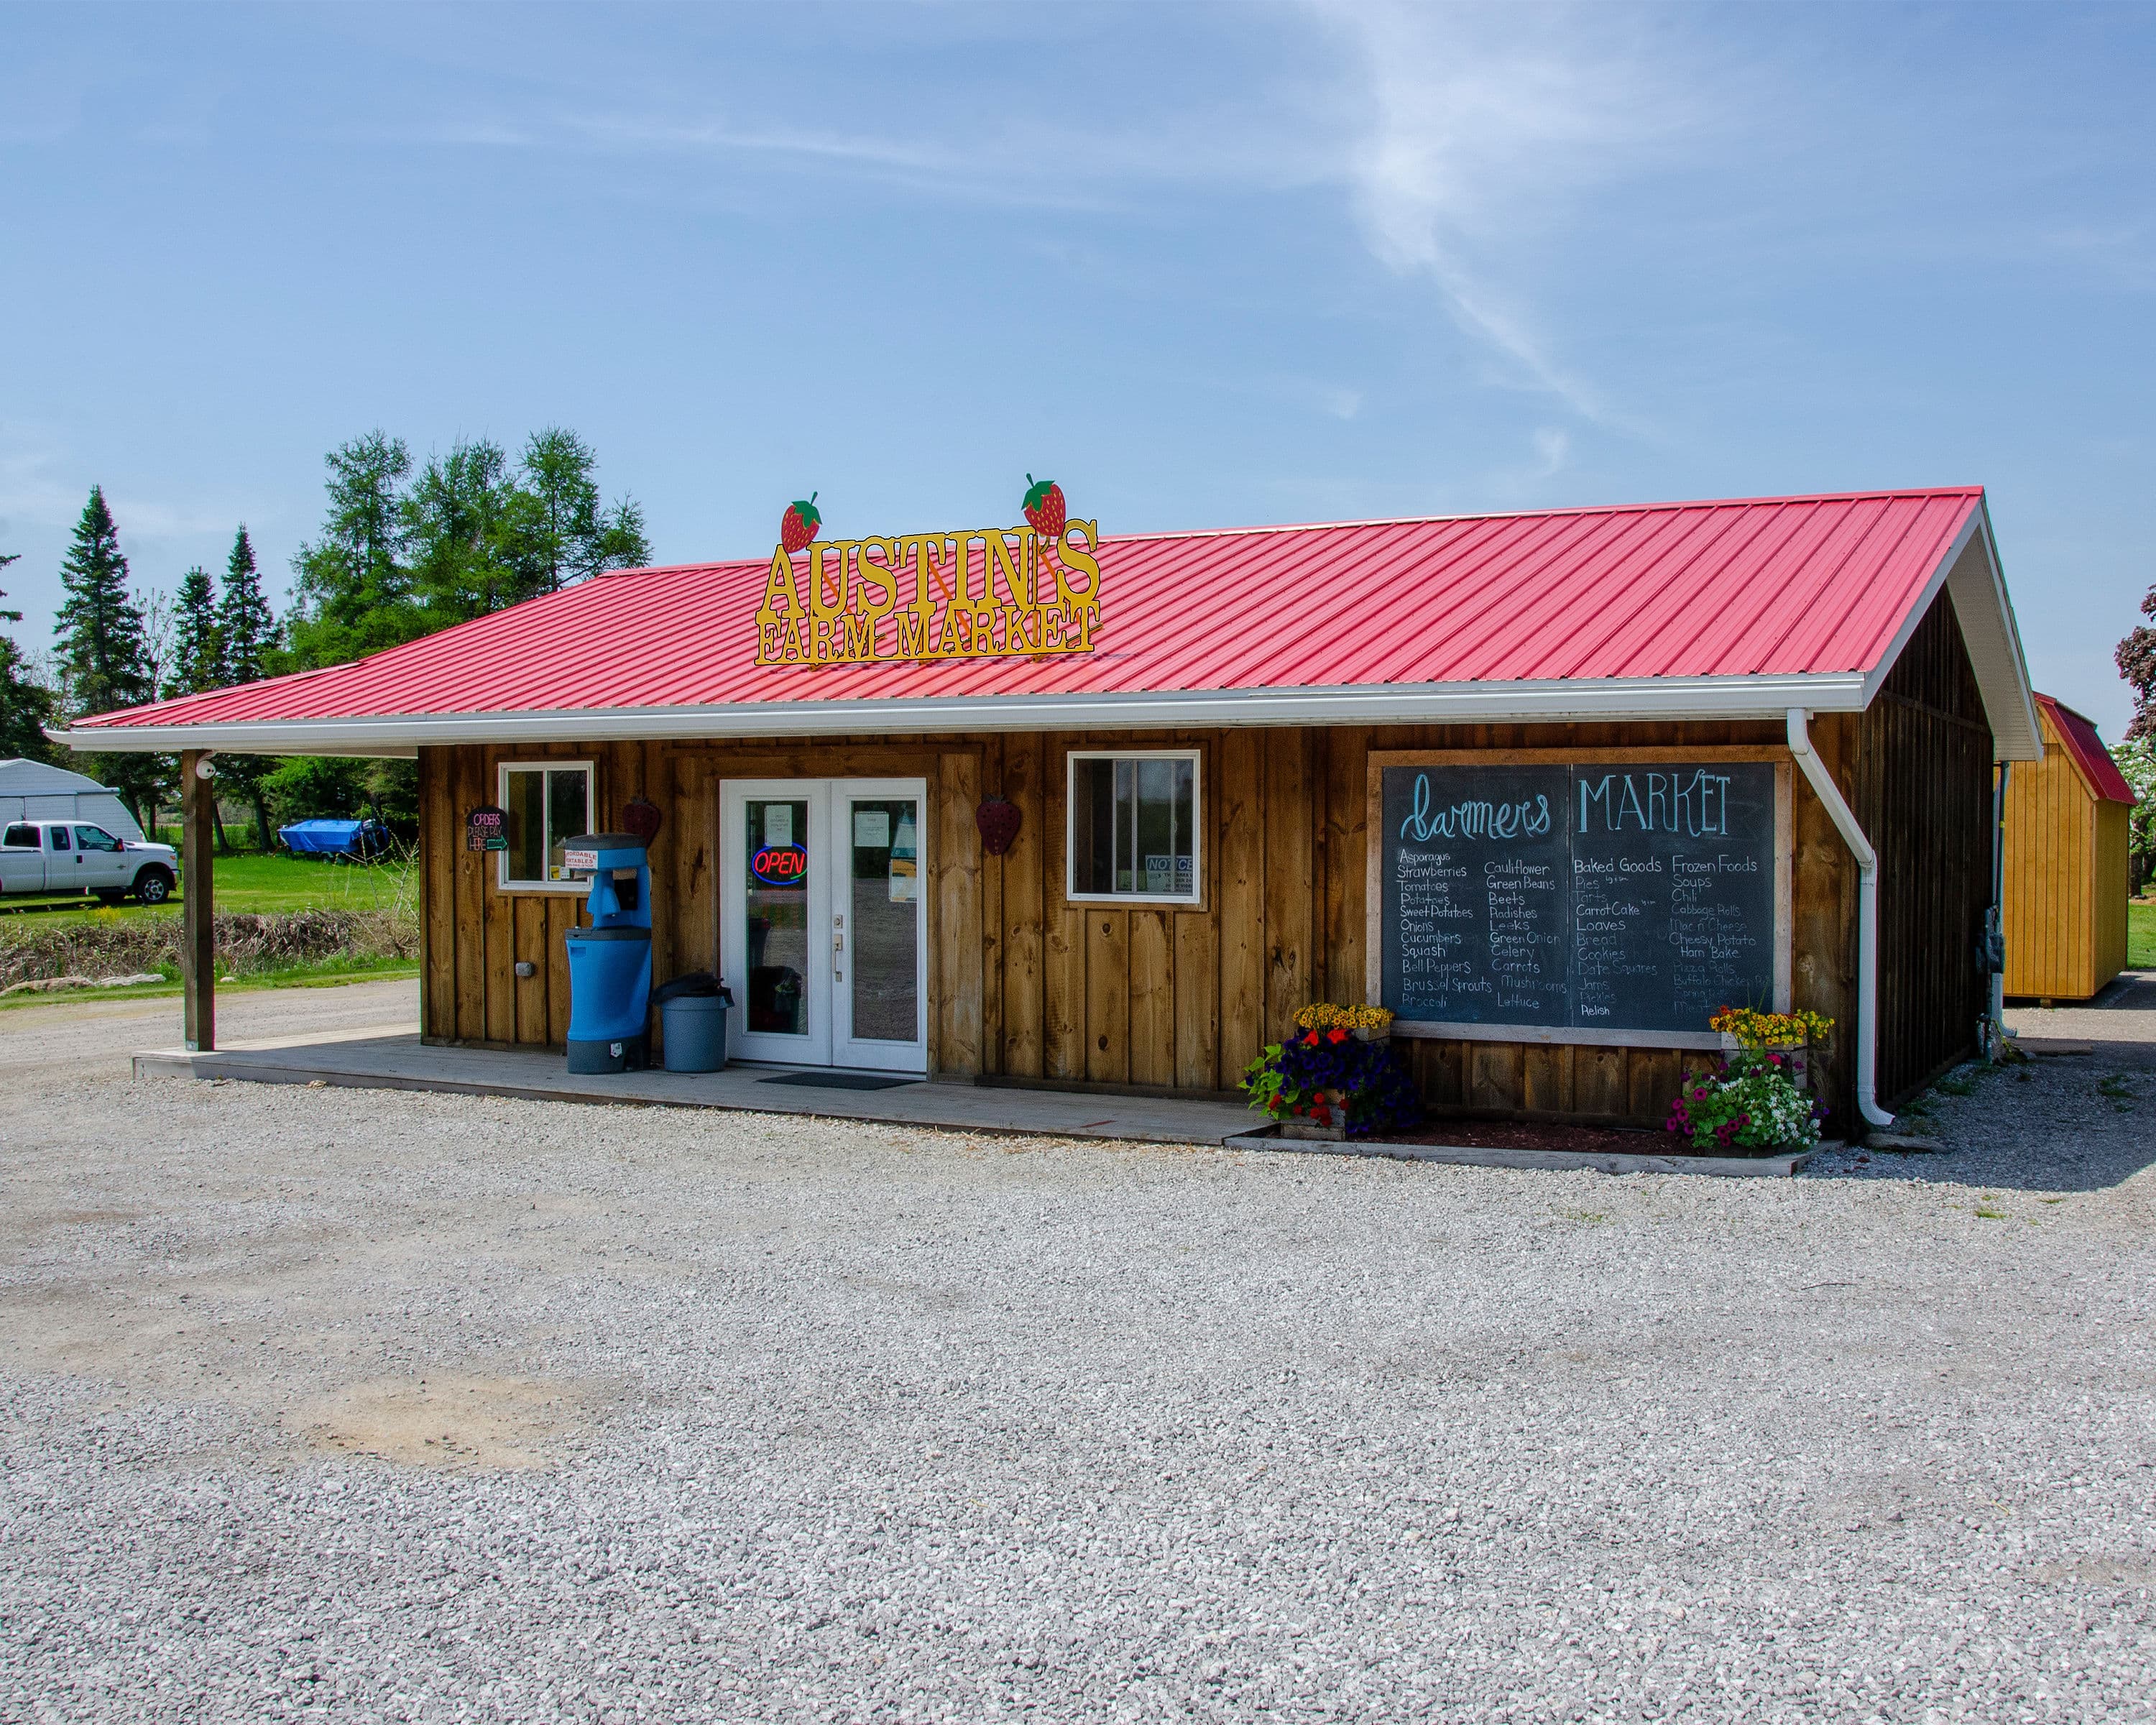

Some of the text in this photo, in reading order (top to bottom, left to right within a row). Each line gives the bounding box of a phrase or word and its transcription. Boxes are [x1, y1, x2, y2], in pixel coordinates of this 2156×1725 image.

[756, 519, 1101, 620] AUSTIN'S
[755, 600, 1101, 666] FARM MARKET
[1577, 768, 1731, 837] MARKET
[473, 813, 501, 826] ORDERS
[467, 826, 502, 838] PLEASE PAY
[755, 852, 805, 874] OPEN
[1399, 848, 1451, 866] Asparagus
[1672, 854, 1758, 873] Frozen Foods
[1396, 862, 1467, 878] Strawberries
[1484, 858, 1550, 875] Cauliflower
[1574, 856, 1662, 874] Baked Goods
[1486, 875, 1556, 890] Green Beans
[1575, 875, 1600, 890] Pies
[1672, 873, 1712, 893] Soups
[1401, 892, 1450, 906] Potatoes
[1488, 891, 1525, 906] Beets
[1572, 891, 1608, 903] Tarts
[1671, 888, 1697, 903] Chili
[1400, 903, 1473, 919] Sweet Potatoes
[1489, 906, 1537, 919] Radishes
[1575, 903, 1611, 916] Carrot
[1611, 901, 1640, 916] Cake
[1671, 902, 1741, 921] Cabbage Rolls
[1400, 919, 1434, 933] Onions
[1489, 919, 1530, 932] Leeks
[1576, 917, 1626, 932] Loaves
[1708, 917, 1747, 932] Cheese
[1401, 929, 1462, 944] Cucumbers
[1490, 931, 1561, 944] Green Onion
[1576, 932, 1617, 947] Bread
[1669, 932, 1756, 948] Cheesy Potato
[1401, 942, 1446, 959] Squash
[1491, 944, 1535, 960] Celery
[1577, 947, 1626, 961] Cookies
[1680, 945, 1741, 959] Ham Bake
[1402, 957, 1472, 978] Bell Peppers
[1491, 958, 1540, 974] Carrots
[1578, 960, 1658, 976] Date Squares
[1403, 976, 1493, 993] Brussel Sprouts
[1577, 977, 1611, 991] Jams
[1402, 993, 1447, 1008] Broccoli
[1497, 991, 1539, 1009] Lettuce
[1581, 1004, 1611, 1017] Relish
